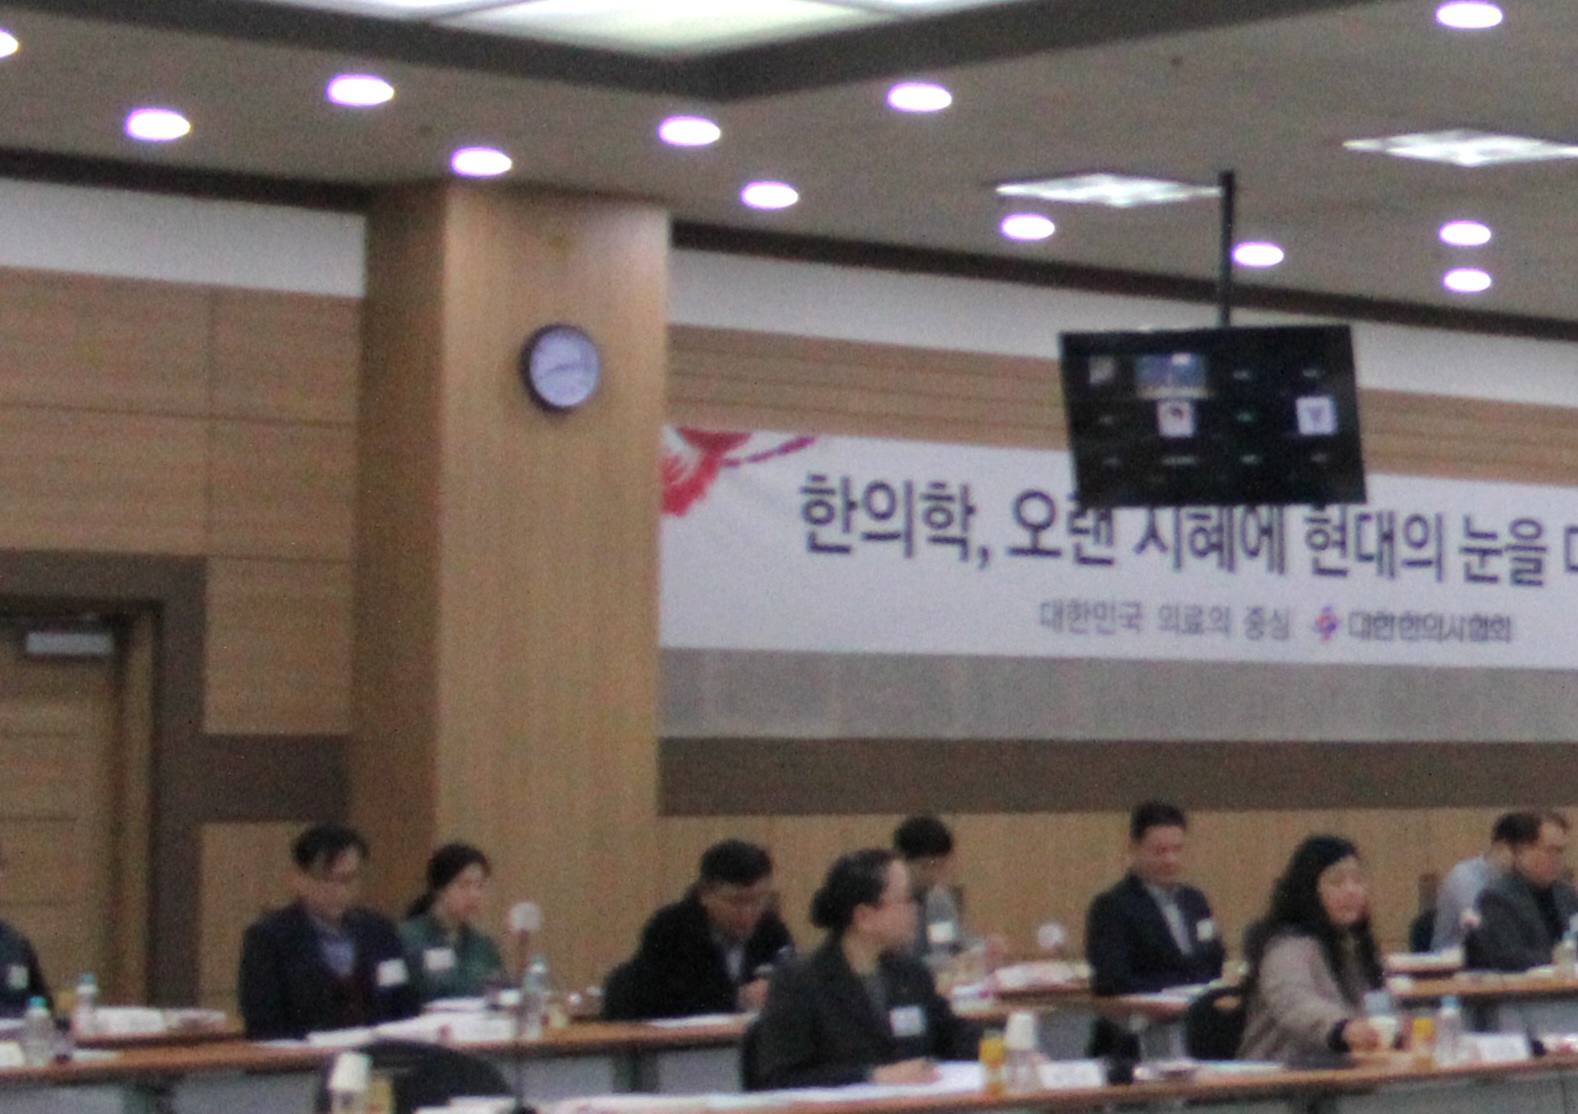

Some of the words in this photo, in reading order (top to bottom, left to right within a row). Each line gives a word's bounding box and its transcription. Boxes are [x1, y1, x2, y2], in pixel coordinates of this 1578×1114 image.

[799, 473, 990, 568] 한의학,
[1007, 489, 1116, 567] 오랜
[1134, 505, 1287, 575] 지혜에
[1304, 503, 1445, 582] 현대의
[1459, 514, 1549, 588] 눈을
[1040, 600, 1145, 635] 대한민국
[1157, 604, 1232, 637] 의료의
[1244, 608, 1291, 641] 중심
[1348, 610, 1512, 643] 대한한의사협회
